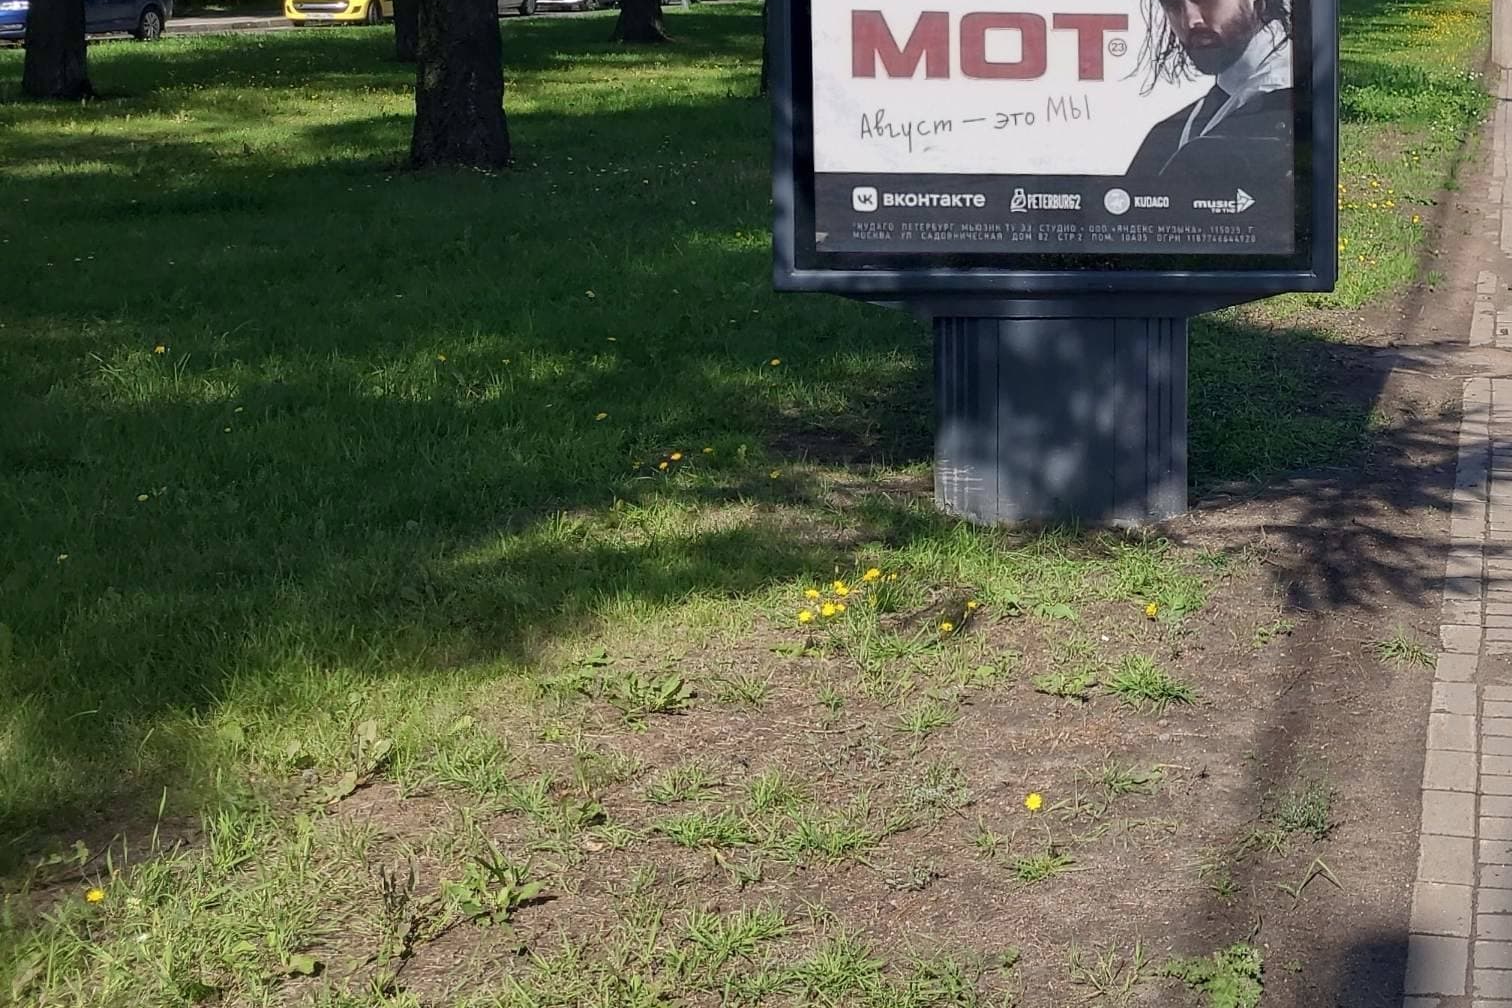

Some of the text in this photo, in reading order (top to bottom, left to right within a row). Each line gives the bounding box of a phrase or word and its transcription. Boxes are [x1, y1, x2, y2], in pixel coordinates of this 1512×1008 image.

[851, 9, 1129, 82] МОТ
[860, 108, 953, 153] Август
[993, 112, 1036, 129] это
[1134, 196, 1170, 209] KUDAGO
